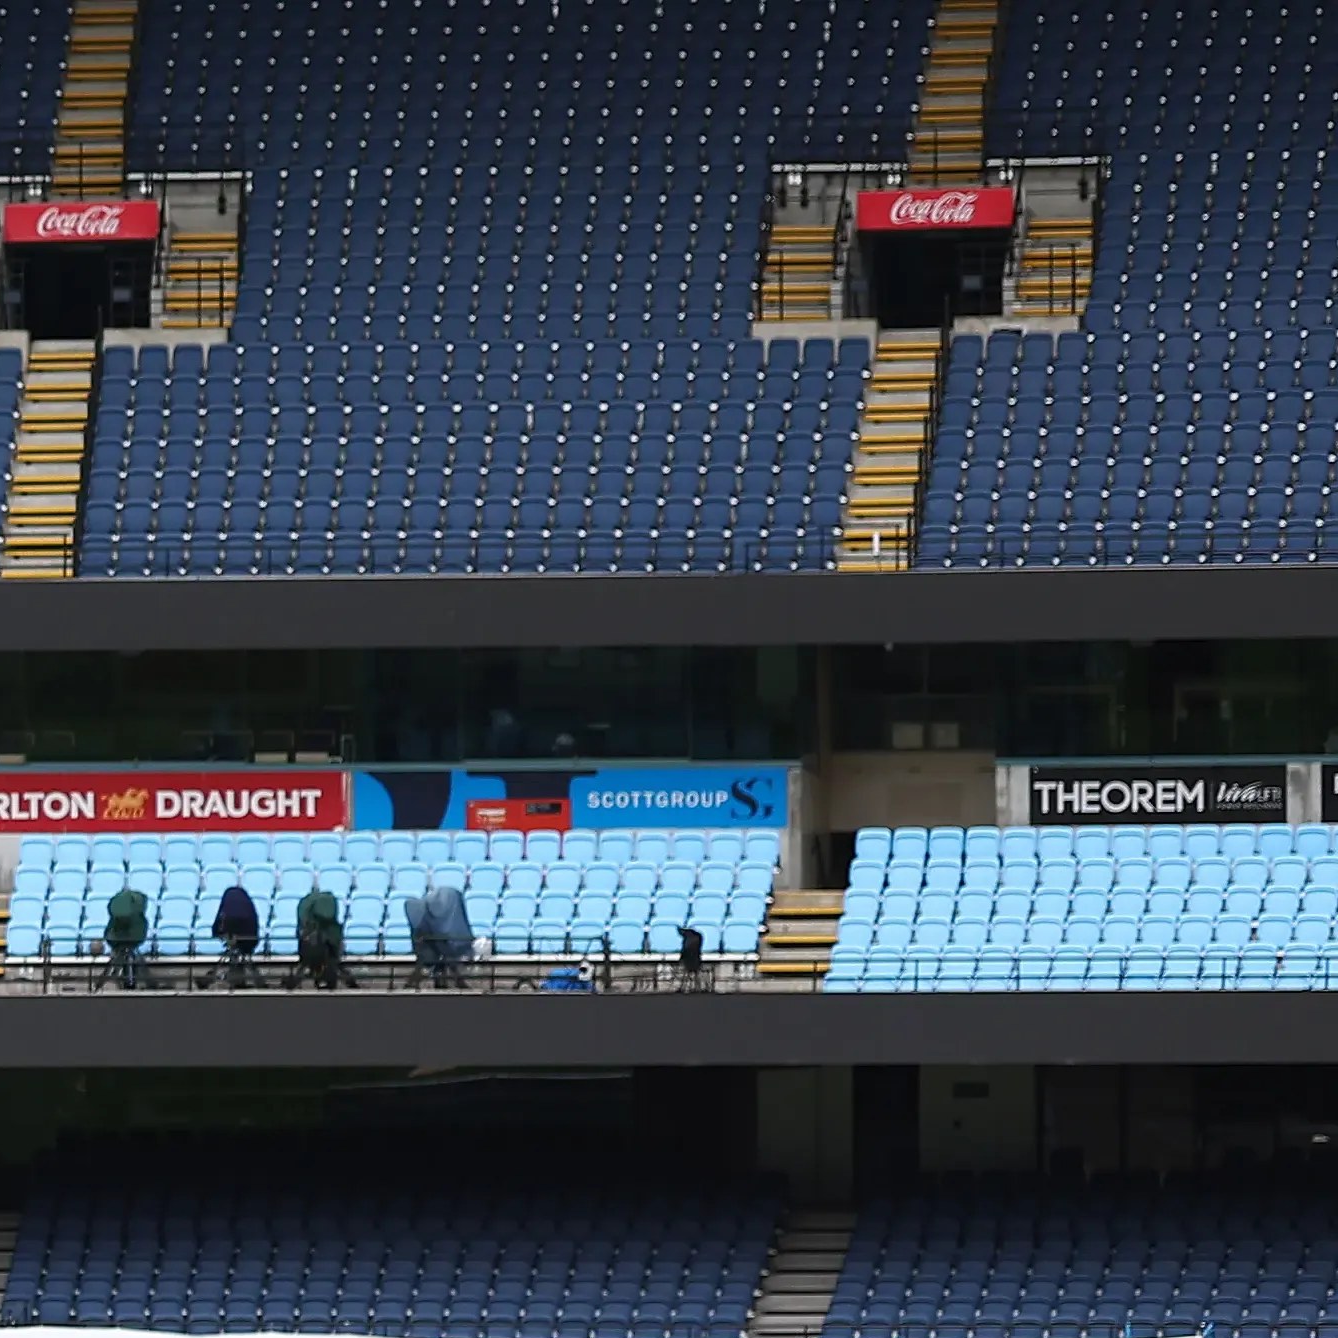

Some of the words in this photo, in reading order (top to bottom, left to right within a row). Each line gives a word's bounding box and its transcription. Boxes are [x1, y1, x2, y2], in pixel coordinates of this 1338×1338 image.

[155, 788, 322, 819] DRAUGHT
[587, 790, 729, 809] SCOTTGROUP
[1033, 780, 1205, 814] THEOREM
